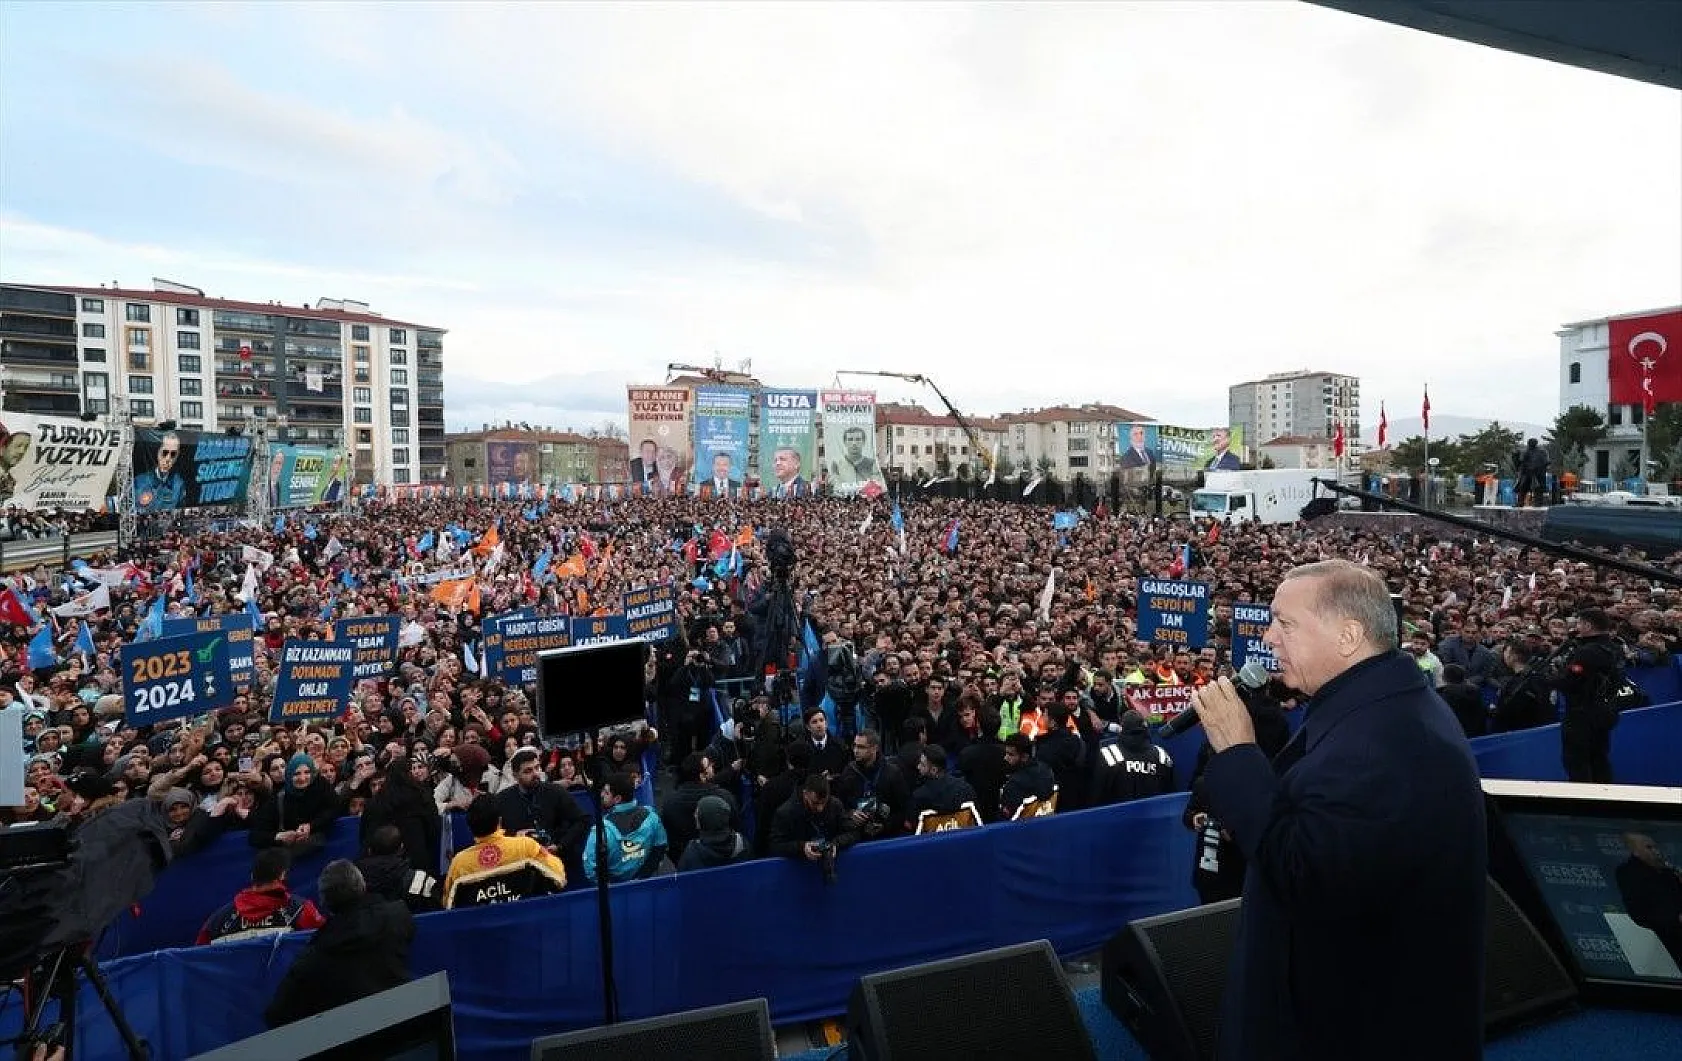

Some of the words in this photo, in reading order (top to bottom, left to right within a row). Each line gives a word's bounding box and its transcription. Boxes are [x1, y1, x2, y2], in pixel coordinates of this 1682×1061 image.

[767, 394, 811, 408] USTA
[1142, 581, 1205, 598] GAKGOŞLAR
[1161, 613, 1183, 627] TAM
[1235, 607, 1269, 622] EKREM
[1155, 628, 1187, 643] SEVER
[302, 647, 352, 662] KAZANMAYA
[132, 650, 191, 683] 2023
[134, 679, 195, 713] 2024
[1133, 688, 1152, 700] AK
